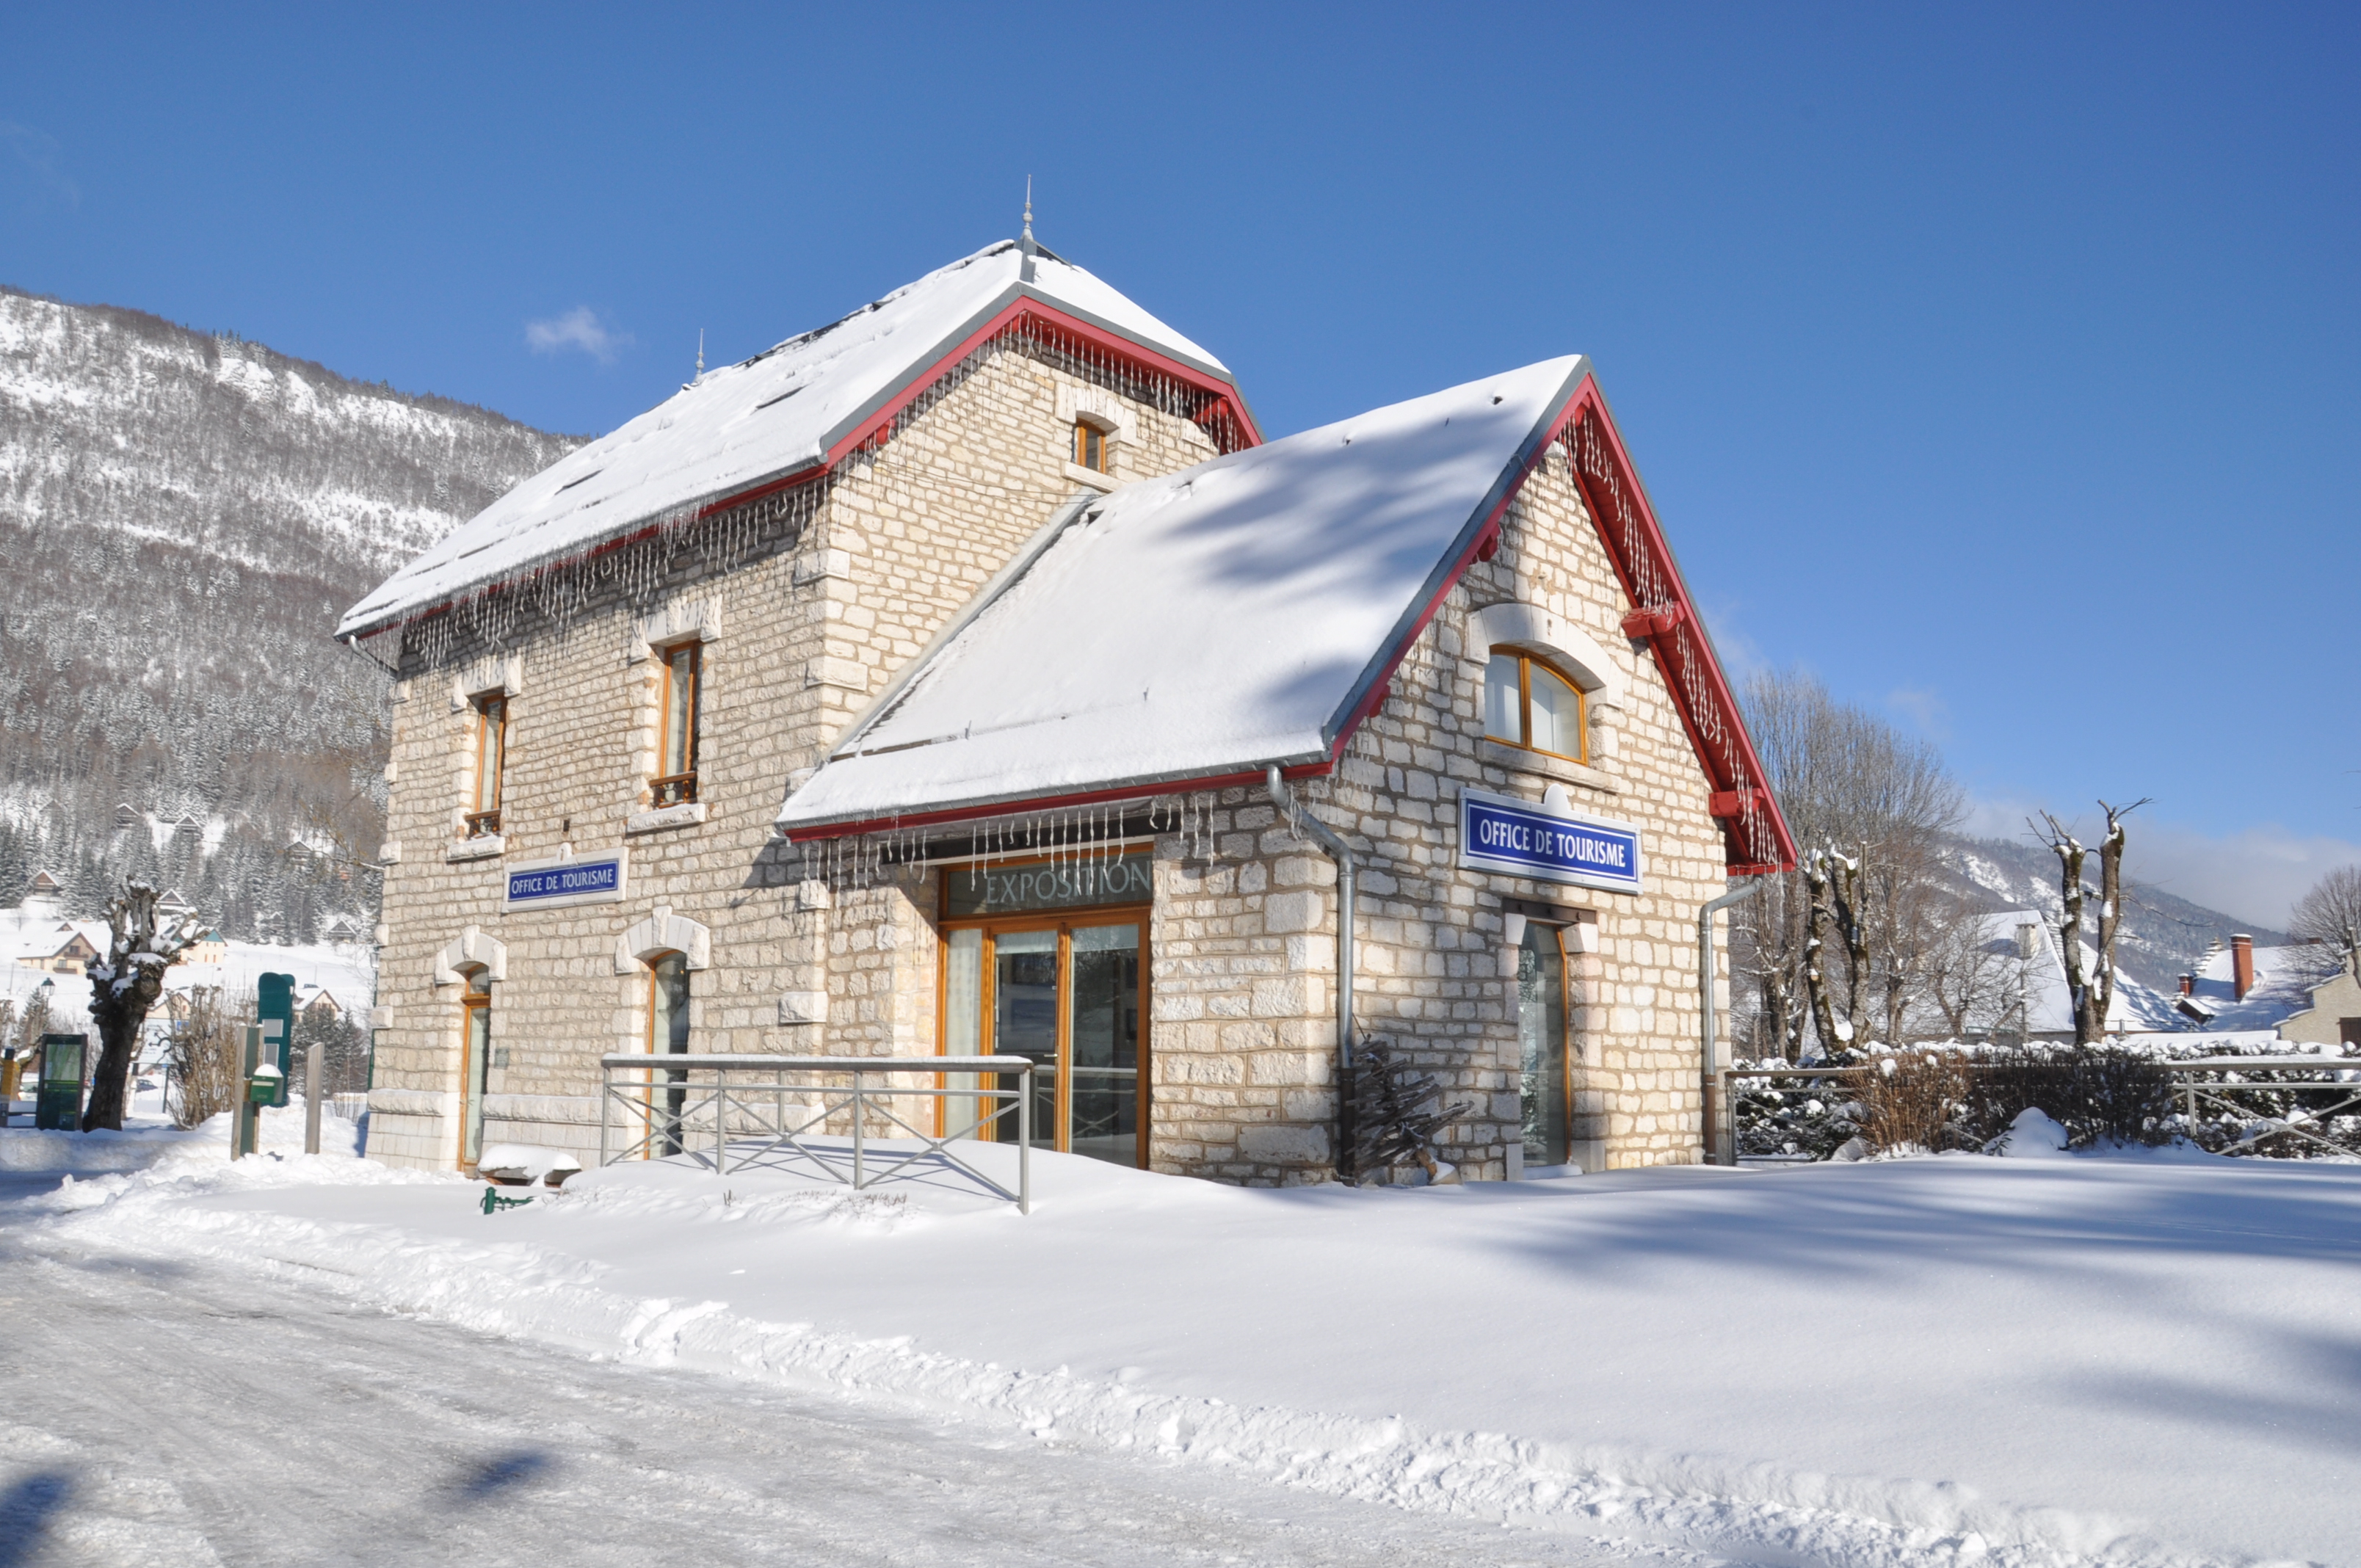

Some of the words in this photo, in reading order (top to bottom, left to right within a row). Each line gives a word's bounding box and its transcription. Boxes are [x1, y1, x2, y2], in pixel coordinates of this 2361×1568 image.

[1480, 819, 1530, 852] OFFICE
[1535, 829, 1553, 855] DE
[1556, 833, 1626, 868] TOURISME
[511, 877, 543, 894] OFFICE
[545, 875, 558, 890] DE
[562, 868, 614, 888] TOURISME
[986, 860, 1151, 904] EXPOSITION
